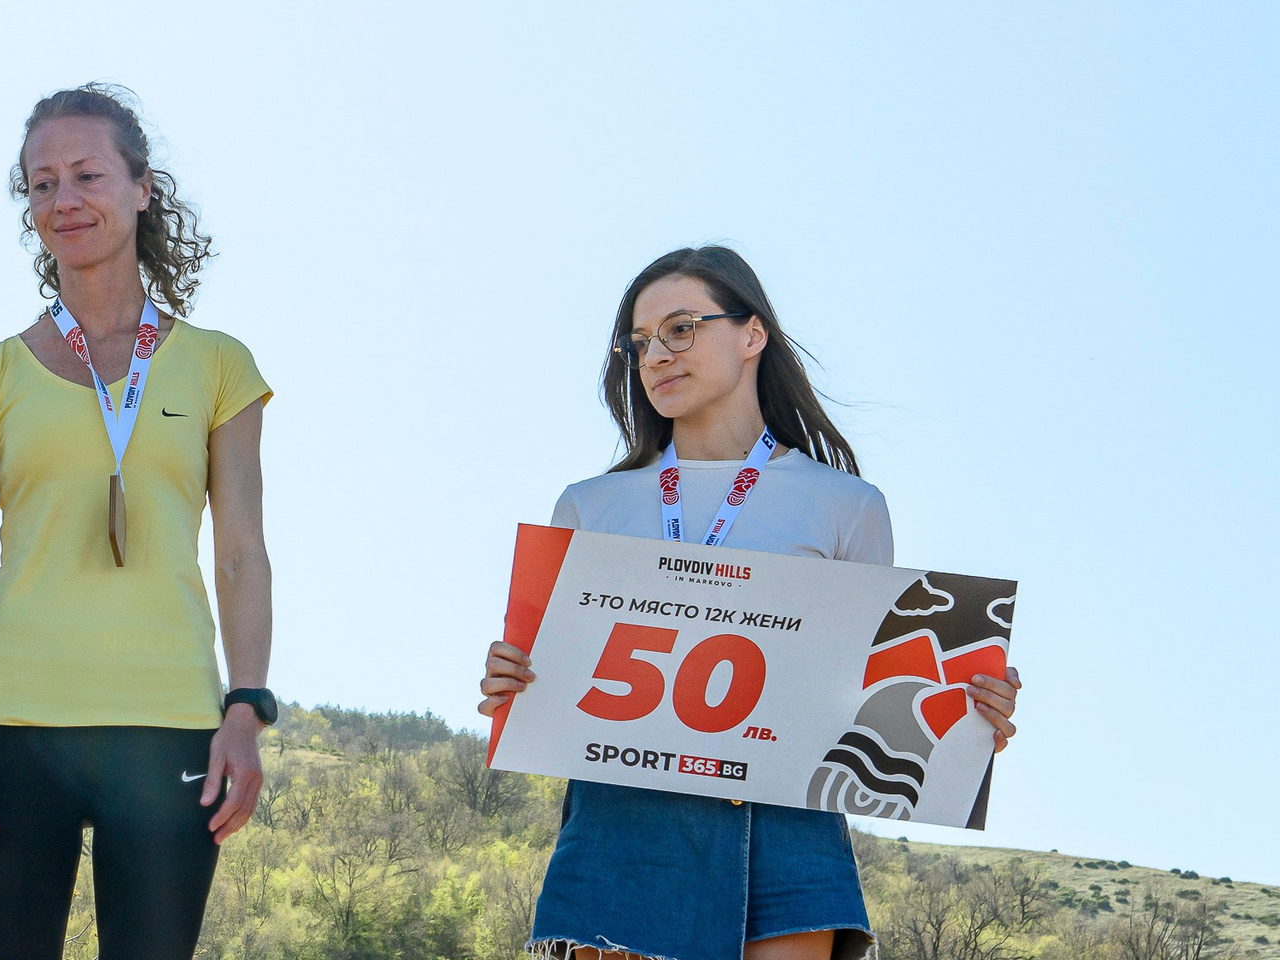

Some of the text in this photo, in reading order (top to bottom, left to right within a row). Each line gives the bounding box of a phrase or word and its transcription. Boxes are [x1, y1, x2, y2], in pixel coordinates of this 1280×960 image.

[658, 556, 752, 581] PLOVDIV HILLS
[688, 577, 733, 588] MARKOVO
[578, 592, 803, 632] 3-ТО МЯСТО 12К ЖЕНИ
[576, 622, 767, 734] 50
[584, 742, 677, 771] SPORT
